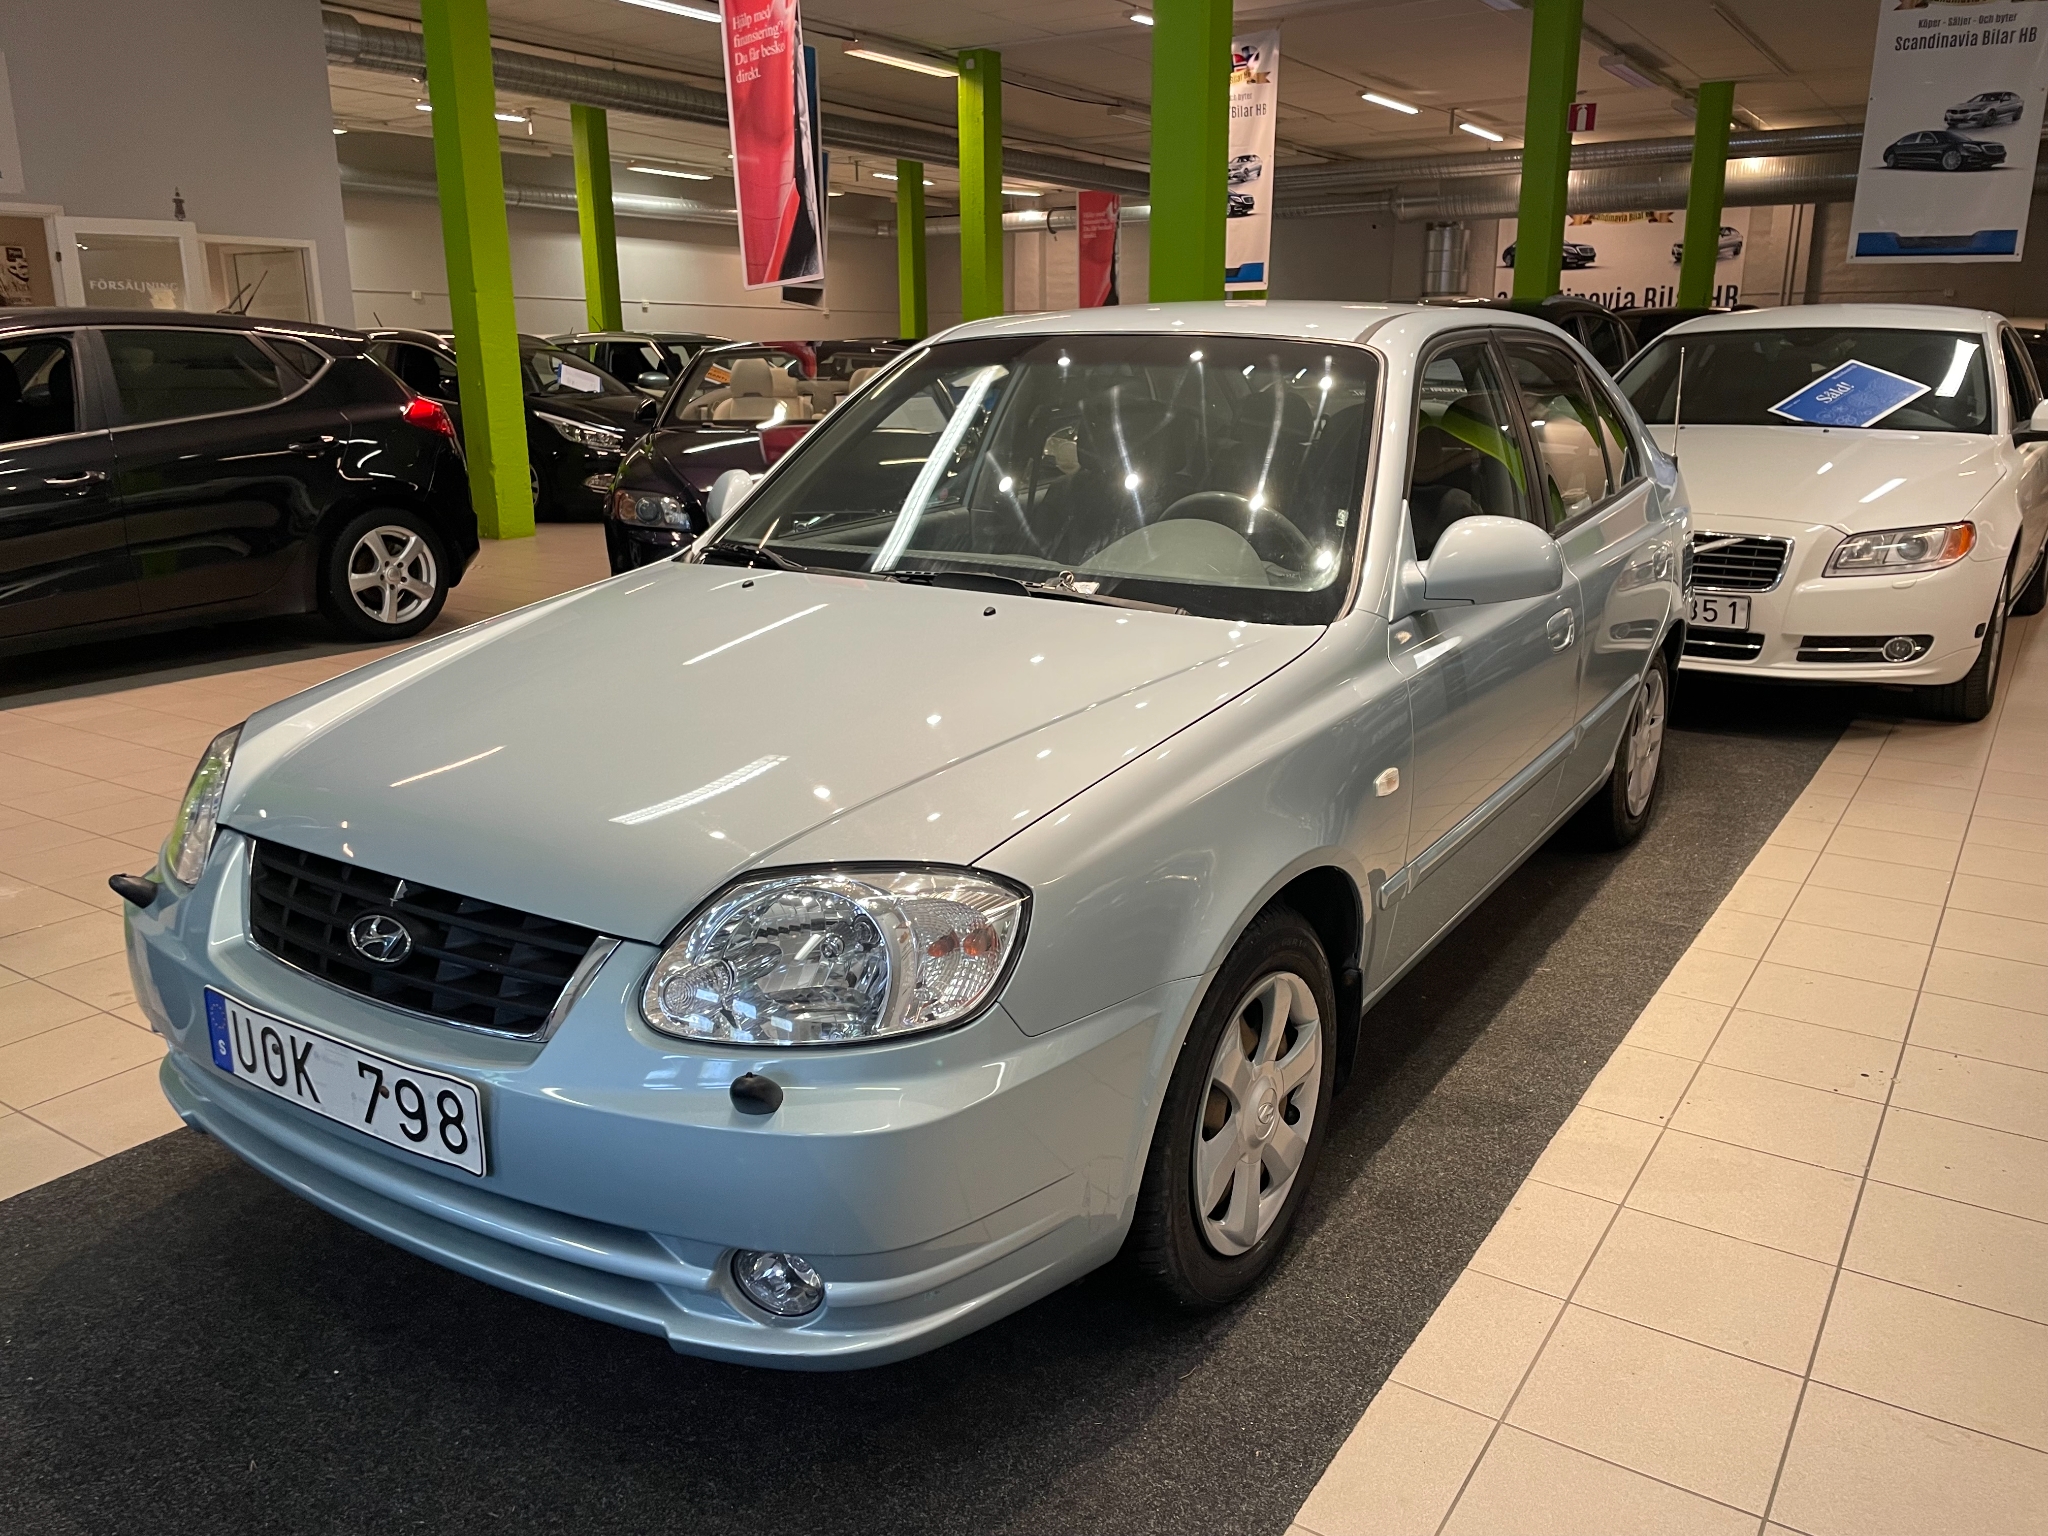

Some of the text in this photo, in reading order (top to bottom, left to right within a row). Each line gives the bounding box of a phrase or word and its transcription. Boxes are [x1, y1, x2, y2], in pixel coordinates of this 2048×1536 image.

[733, 4, 771, 32] Hjälp med
[1918, 19, 1942, 29] Köper
[1947, 16, 1972, 27] Säljer
[1978, 14, 1993, 24] Och
[1995, 13, 2018, 24] byter
[734, 20, 784, 48] finansiering?
[1894, 26, 2038, 51] Scandinavia Bilar HB
[734, 52, 748, 66] Du
[749, 47, 760, 61] får
[1231, 103, 1267, 118] Bilar HB
[90, 278, 179, 293] FÖRSÄLJNING
[1815, 381, 1855, 404] Såld!
[218, 1039, 227, 1056] S
[231, 1010, 469, 1155] UOK 798
